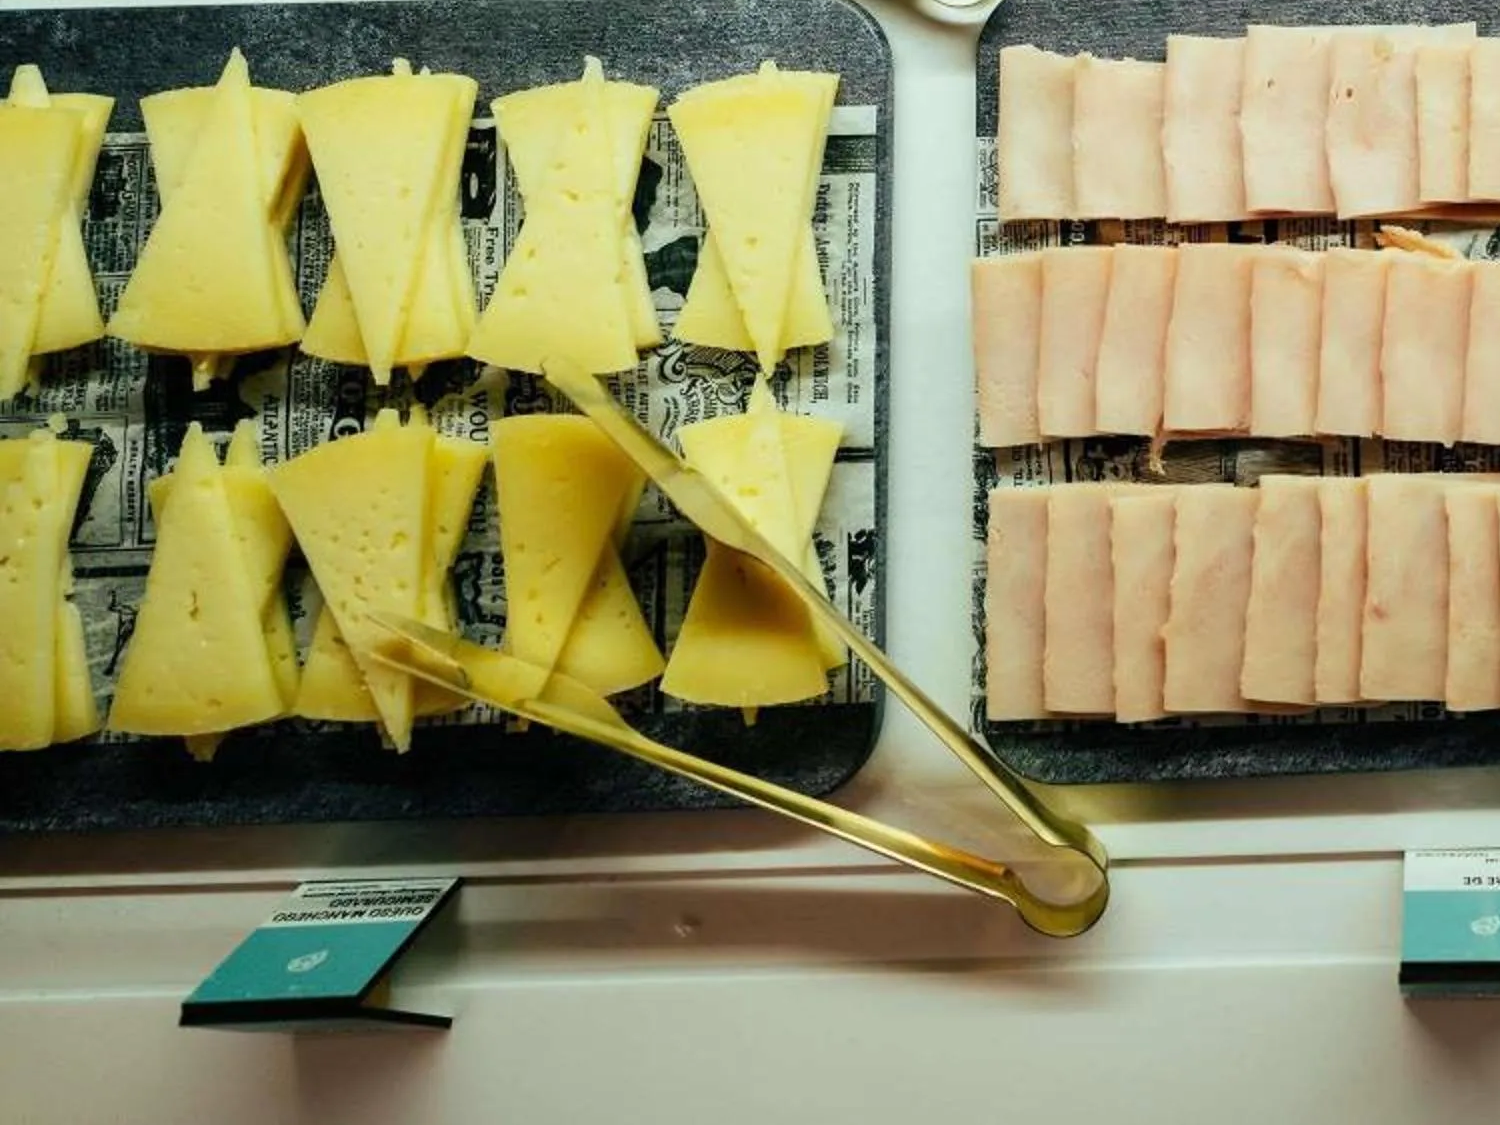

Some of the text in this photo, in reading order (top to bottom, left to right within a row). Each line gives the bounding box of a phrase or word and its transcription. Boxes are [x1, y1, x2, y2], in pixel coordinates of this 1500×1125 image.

[484, 226, 499, 266] Free
[1462, 876, 1483, 886] DE
[272, 906, 424, 922] QUESO MANCHEGO
